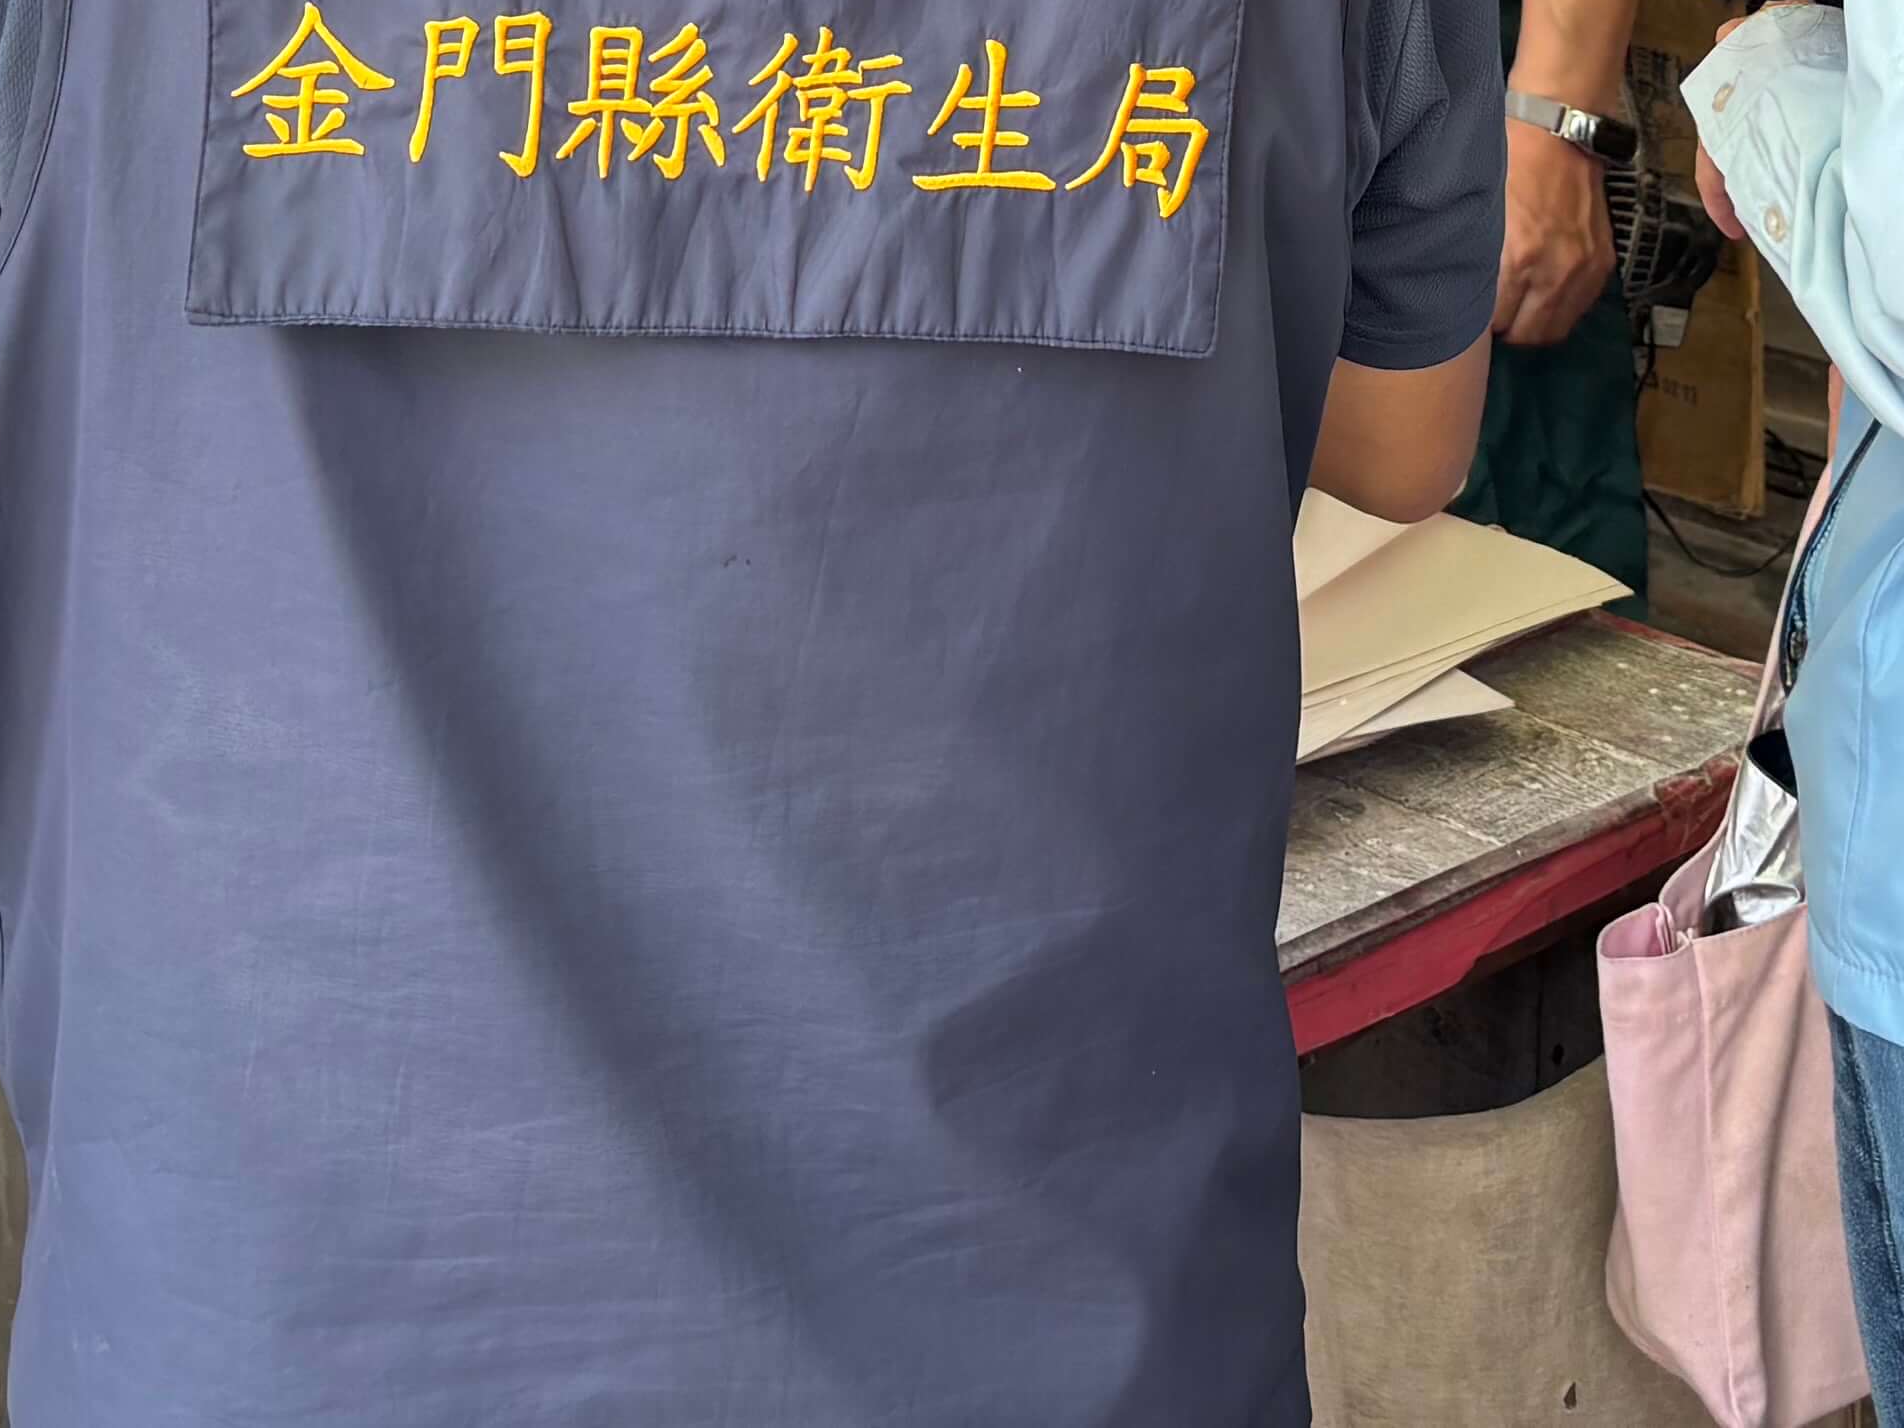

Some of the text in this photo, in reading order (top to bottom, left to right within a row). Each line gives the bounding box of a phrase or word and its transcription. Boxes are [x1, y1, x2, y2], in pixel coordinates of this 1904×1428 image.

[230, 1, 1210, 219] 金門縣衛生局
